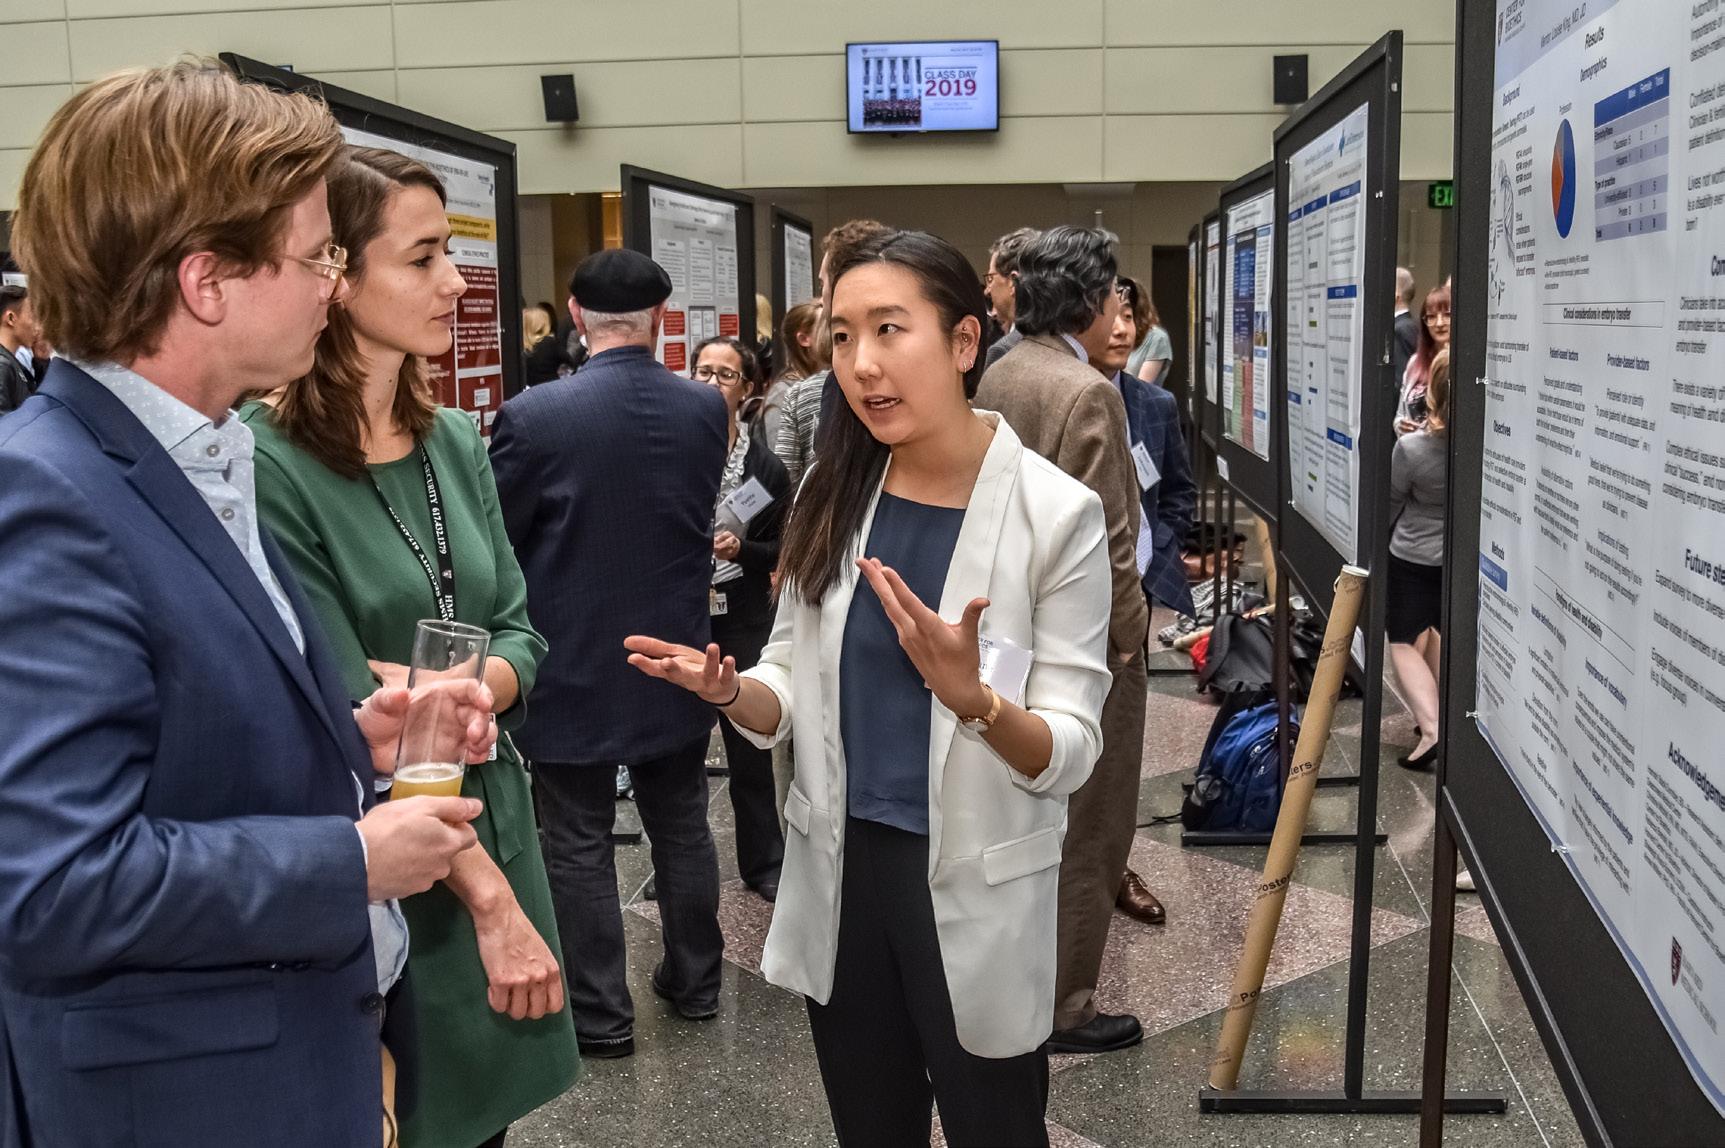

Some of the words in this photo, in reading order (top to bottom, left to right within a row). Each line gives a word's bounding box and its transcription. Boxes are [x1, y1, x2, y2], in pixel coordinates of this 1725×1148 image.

[1585, 27, 1604, 50] Results
[924, 70, 956, 80] CLASS
[958, 70, 977, 80] DAY
[1580, 57, 1607, 82] Demographics
[924, 79, 977, 97] 2019
[1503, 84, 1520, 106] Background
[1563, 307, 1575, 320] Clinical
[1607, 354, 1635, 369] Provider-based
[1494, 419, 1511, 437] Objectives
[424, 462, 438, 504] SECURITY
[431, 507, 448, 555] 617.432.1379
[1491, 541, 1504, 561] Methods
[418, 552, 442, 597] SECURITY
[1685, 548, 1712, 580] Future
[444, 594, 455, 619] HMS
